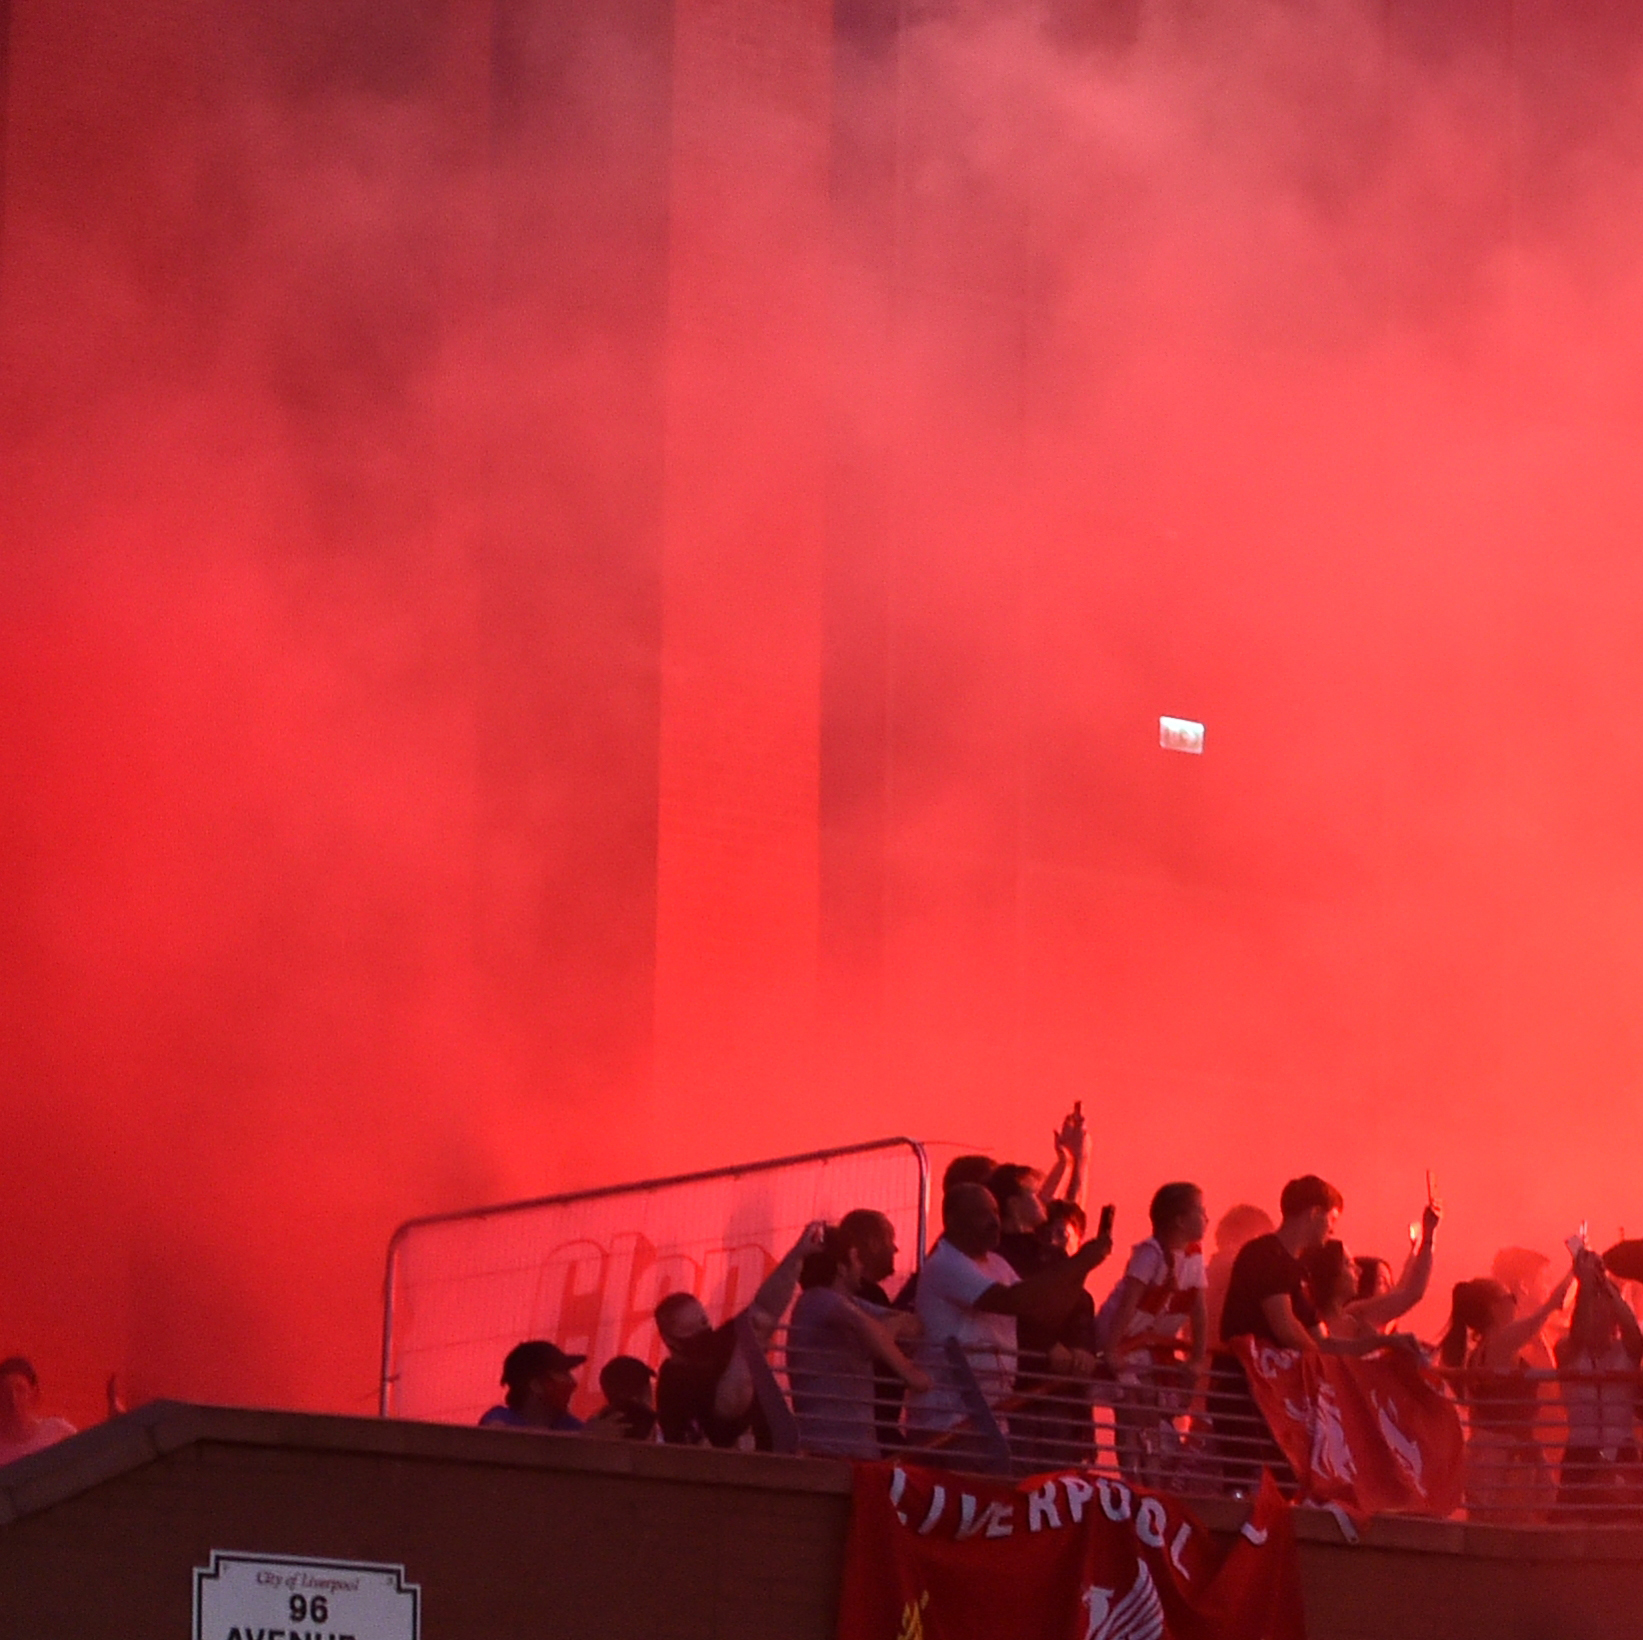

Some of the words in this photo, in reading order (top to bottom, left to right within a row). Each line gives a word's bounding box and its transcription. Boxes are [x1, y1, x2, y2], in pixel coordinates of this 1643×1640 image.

[256, 1571, 283, 1590] City
[285, 1571, 301, 1591] of
[301, 1572, 360, 1596] Liverpool
[289, 1594, 329, 1623] 96
